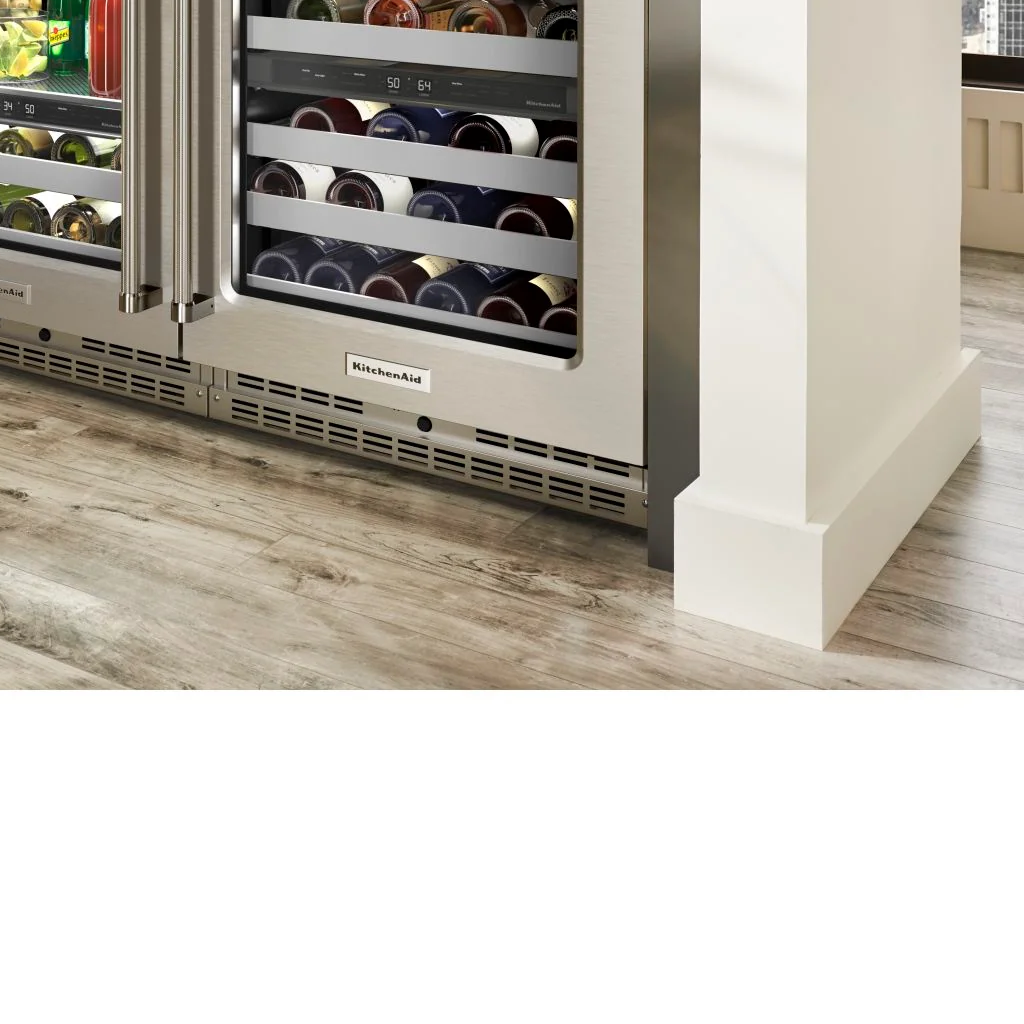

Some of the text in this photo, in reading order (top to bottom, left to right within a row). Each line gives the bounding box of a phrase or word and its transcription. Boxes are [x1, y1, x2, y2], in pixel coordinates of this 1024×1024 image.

[387, 77, 431, 91] 50 64
[3, 101, 35, 114] 34 50
[526, 100, 561, 108] KitchenAid
[352, 361, 422, 384] KitchenAid
